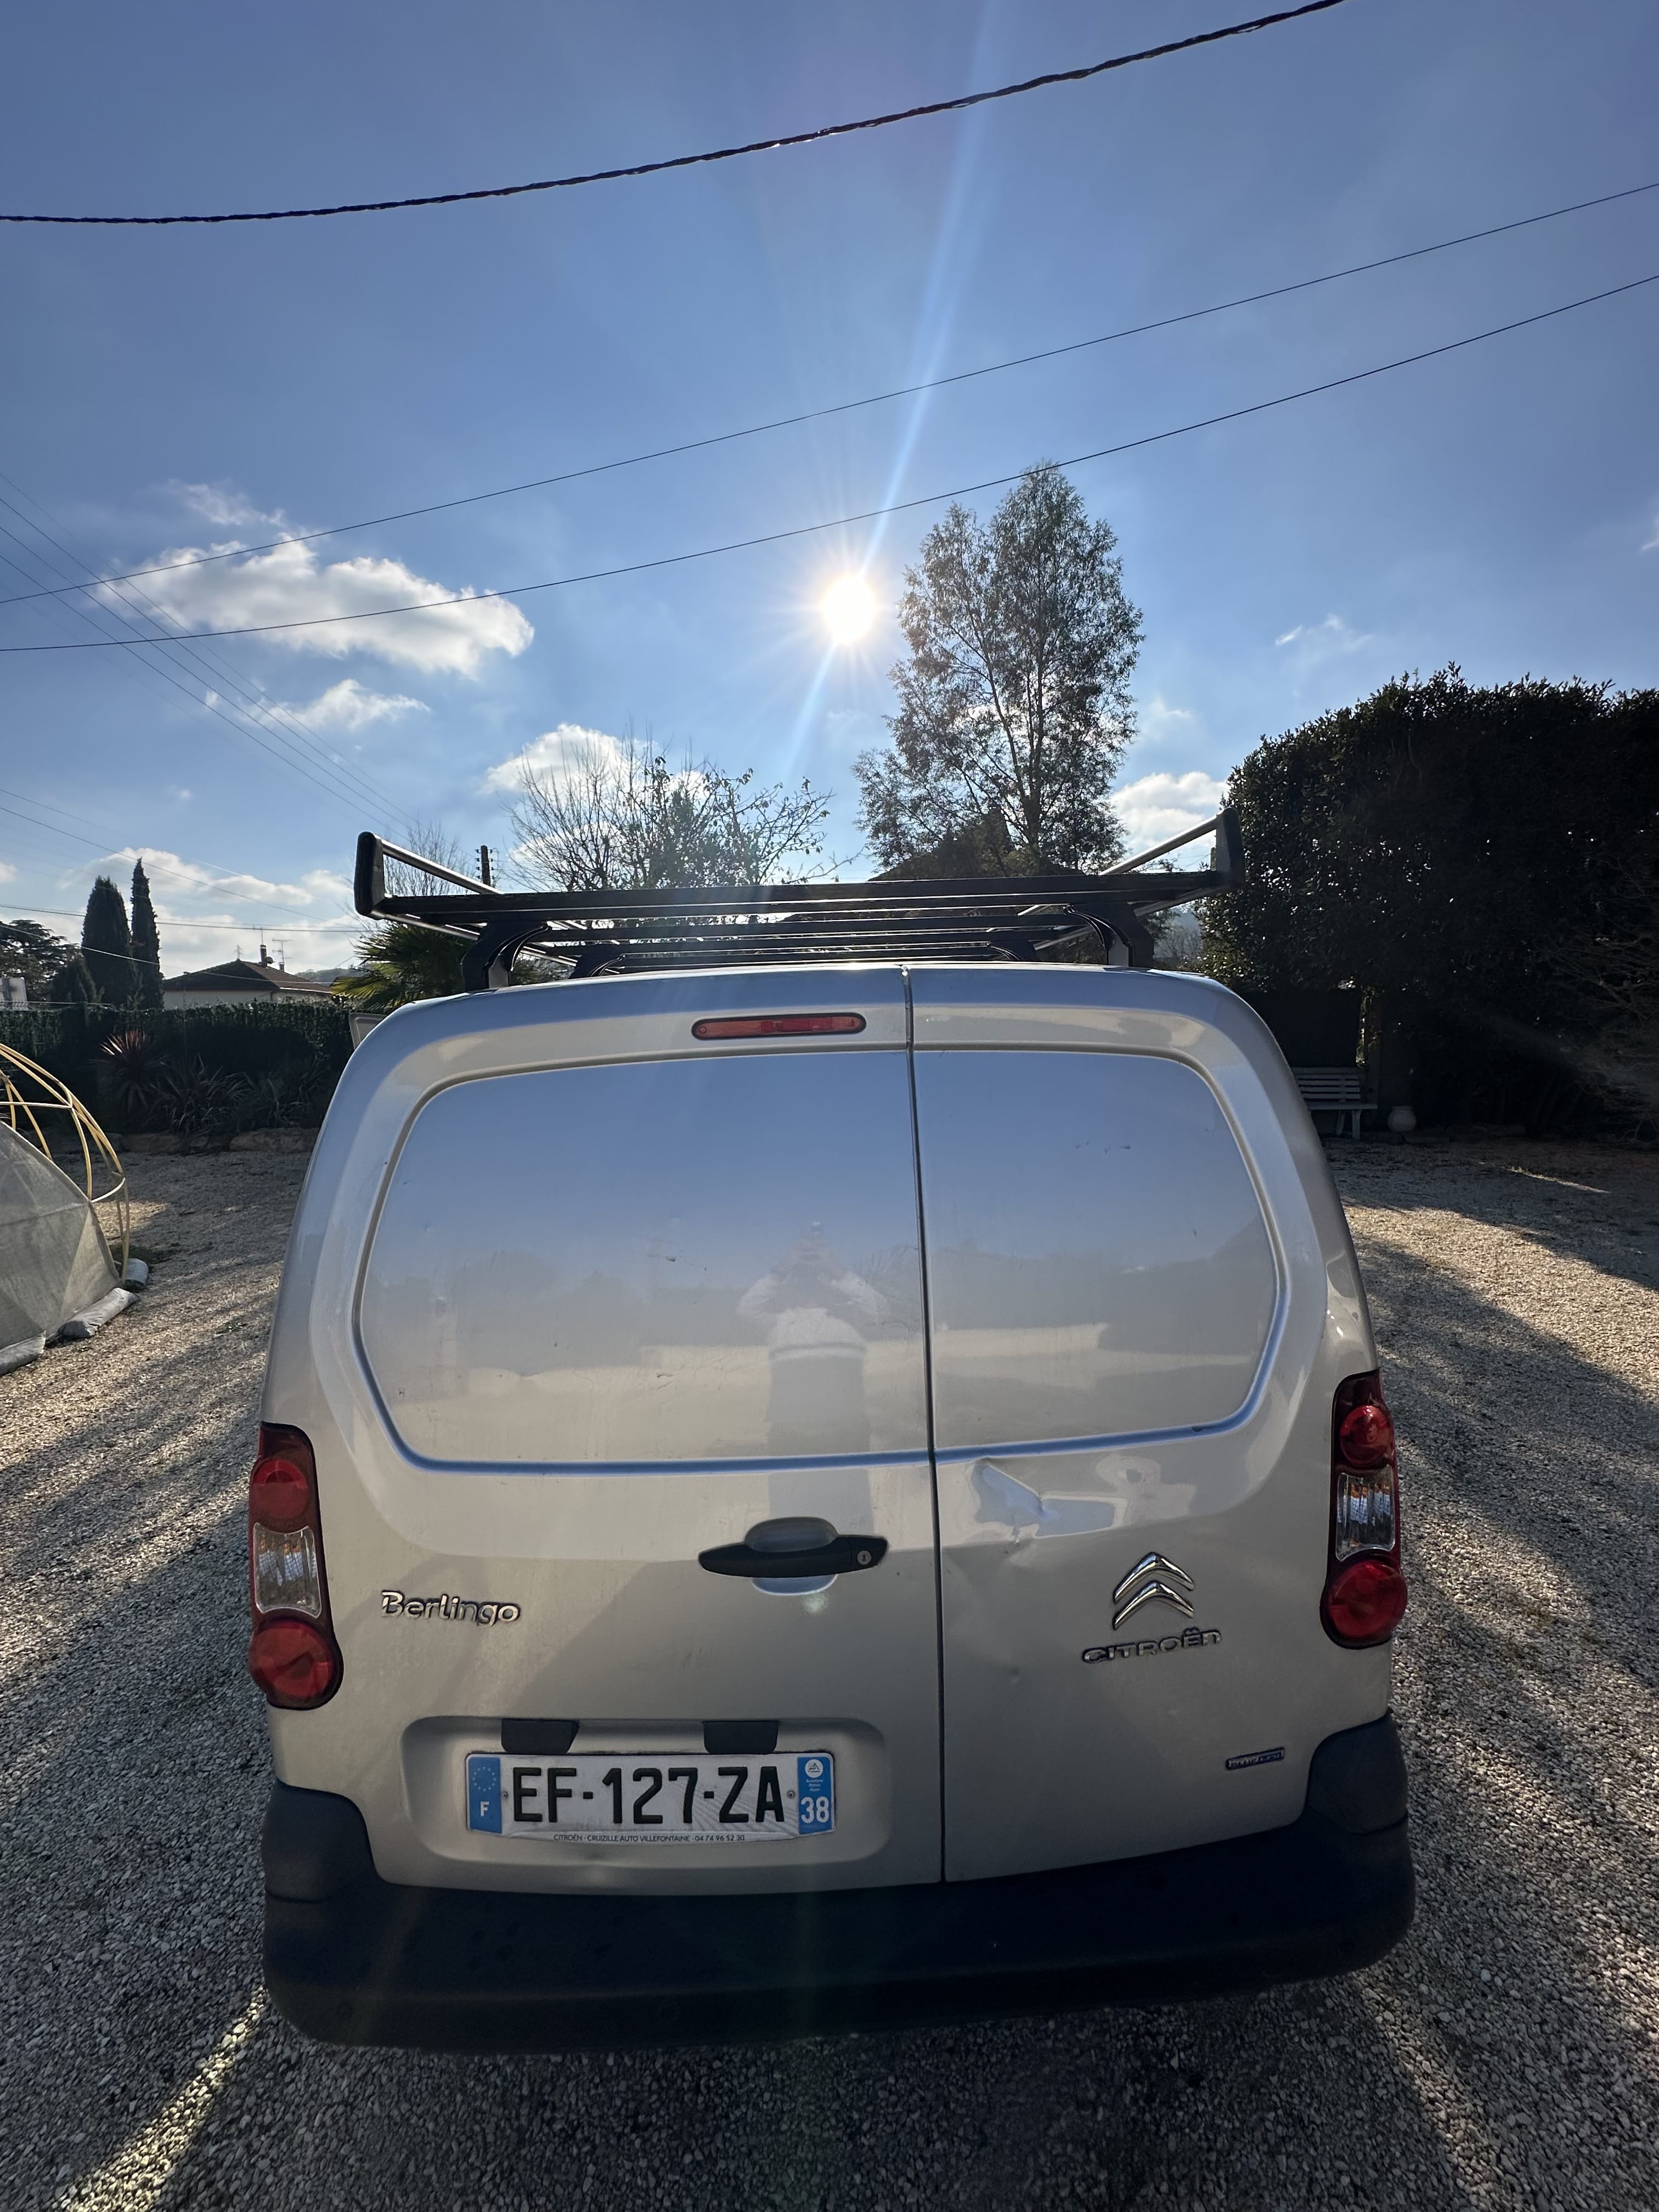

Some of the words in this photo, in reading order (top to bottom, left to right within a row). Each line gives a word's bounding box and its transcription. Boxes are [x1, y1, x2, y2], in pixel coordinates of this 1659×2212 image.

[381, 1590, 521, 1628] Berlingo
[479, 1801, 489, 1818] F
[512, 1766, 785, 1824] EF-127-ZA
[800, 1796, 830, 1824] 38
